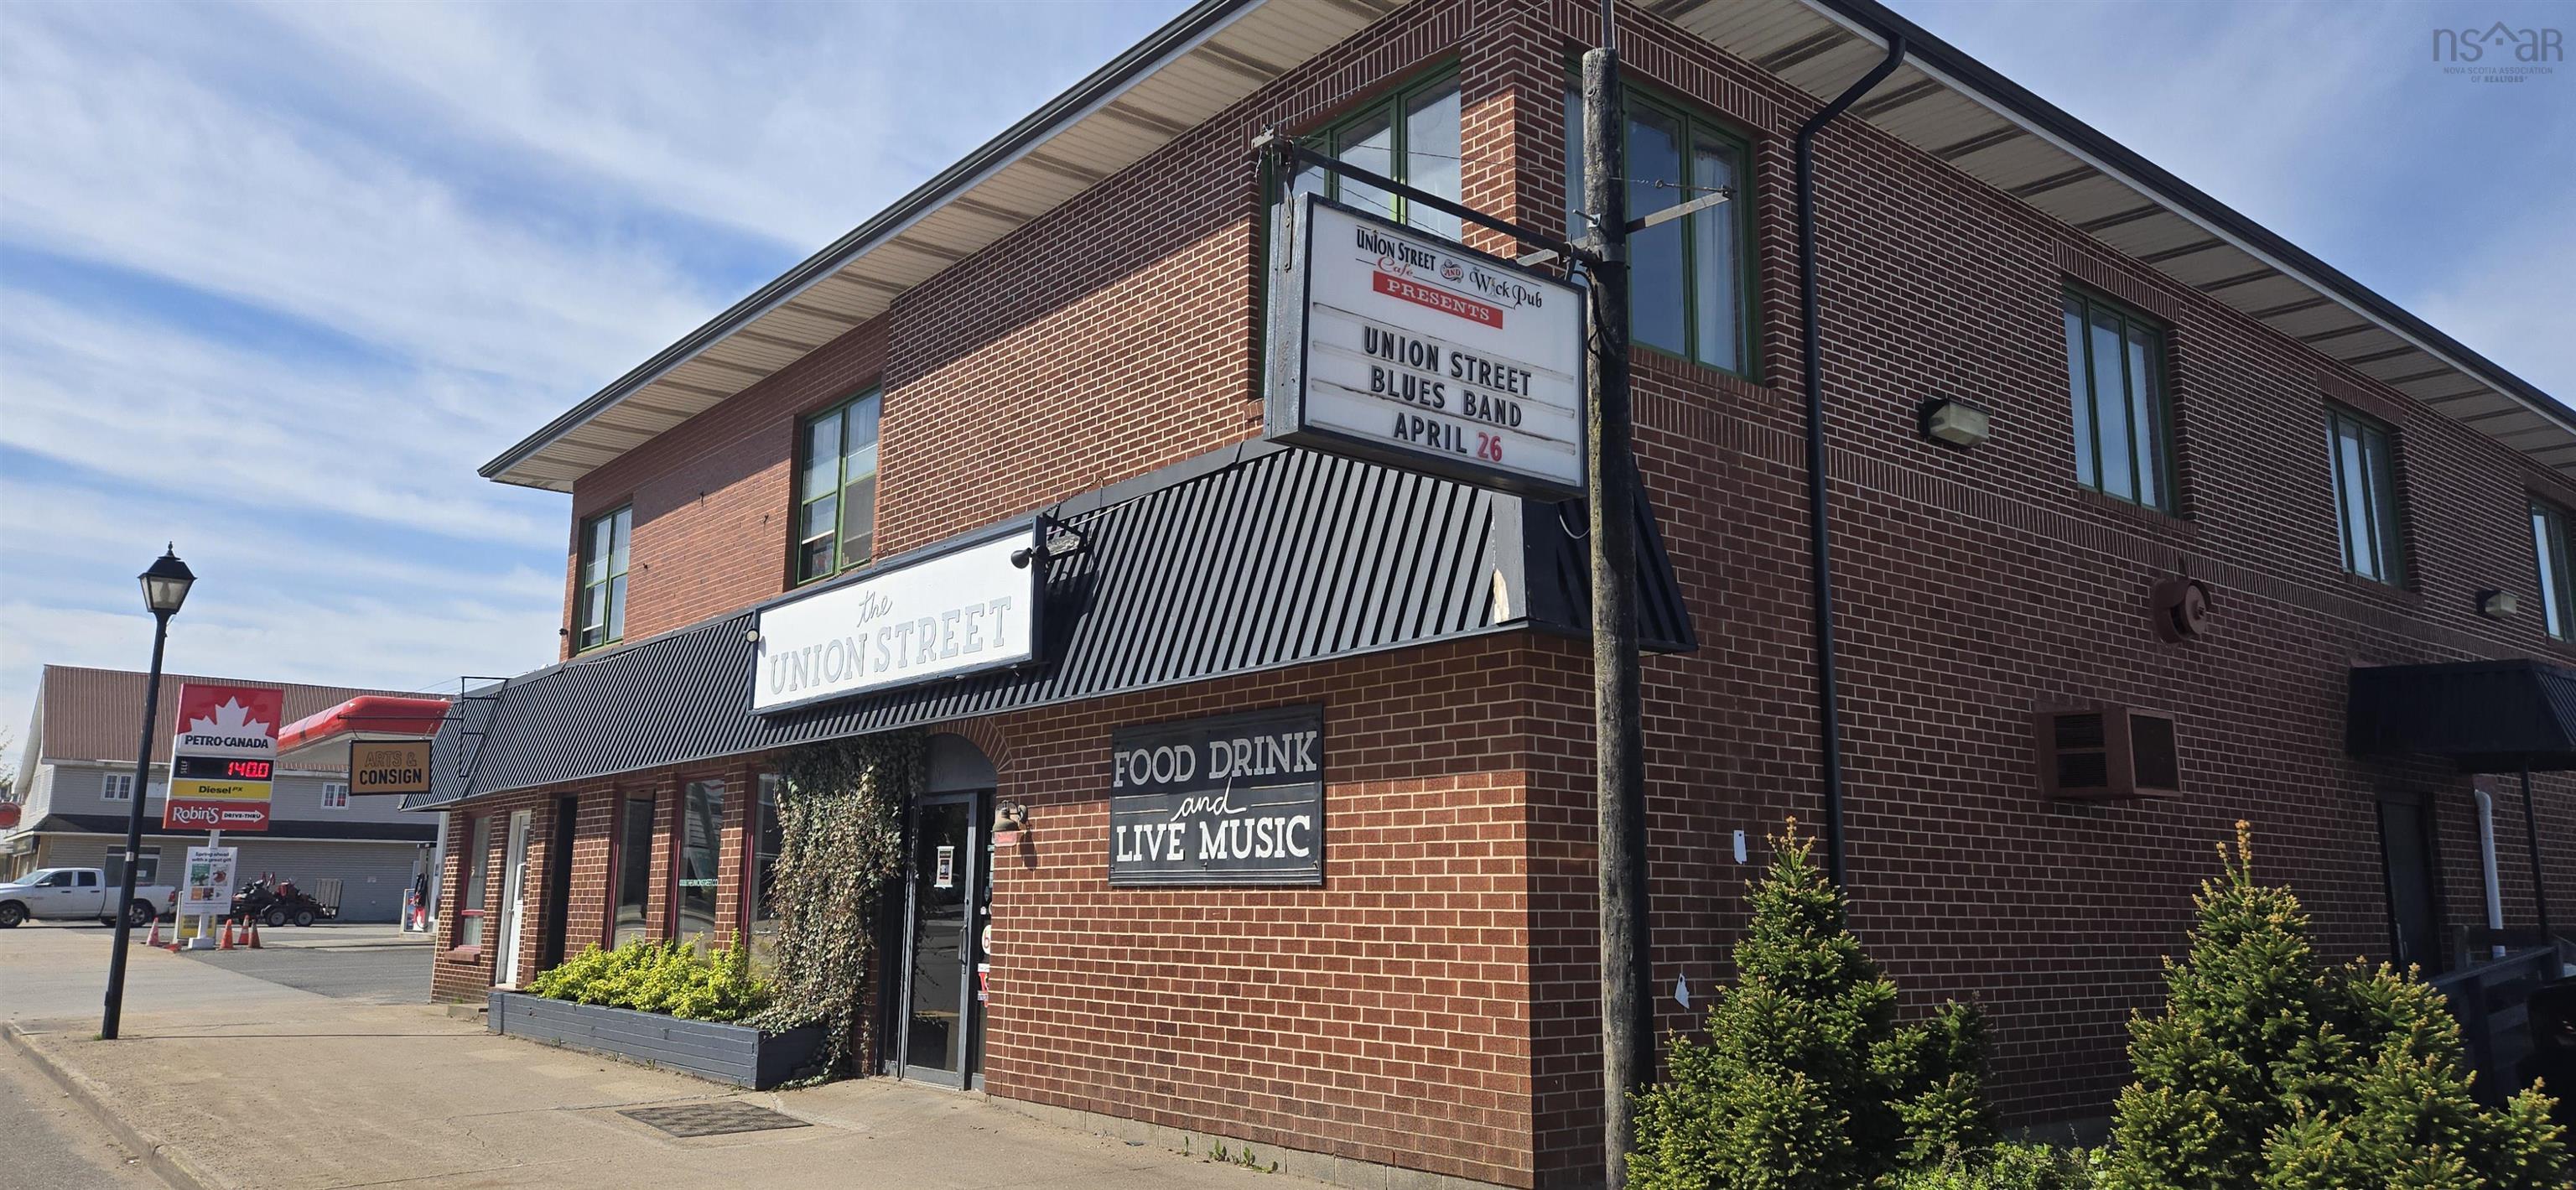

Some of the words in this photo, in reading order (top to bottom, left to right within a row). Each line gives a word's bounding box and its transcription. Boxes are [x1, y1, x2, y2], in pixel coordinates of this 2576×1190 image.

[1357, 228, 1394, 258] UNION
[1398, 242, 1436, 271] STREET
[1444, 268, 1461, 278] AND
[1387, 278, 1490, 321] PRESENTS
[1512, 285, 1542, 310] Pub
[1363, 326, 1440, 372] UNION
[1451, 351, 1531, 396] STREET
[1371, 365, 1446, 409] BLUES
[1463, 389, 1522, 428] BAND
[1394, 412, 1467, 454] APRIL
[1478, 432, 1503, 462] 26
[856, 590, 892, 627] the
[770, 633, 867, 694] UNION
[874, 595, 1011, 672] STREET
[360, 768, 422, 785] CONSIGN
[364, 751, 402, 767] ARTS
[407, 751, 417, 766] &
[1113, 745, 1196, 787] FOOD
[1208, 731, 1317, 779] DRINK
[199, 786, 231, 794] Diesel
[1171, 777, 1247, 822] and
[1116, 822, 1186, 862] LIVE
[1199, 815, 1311, 860] MUSIC
